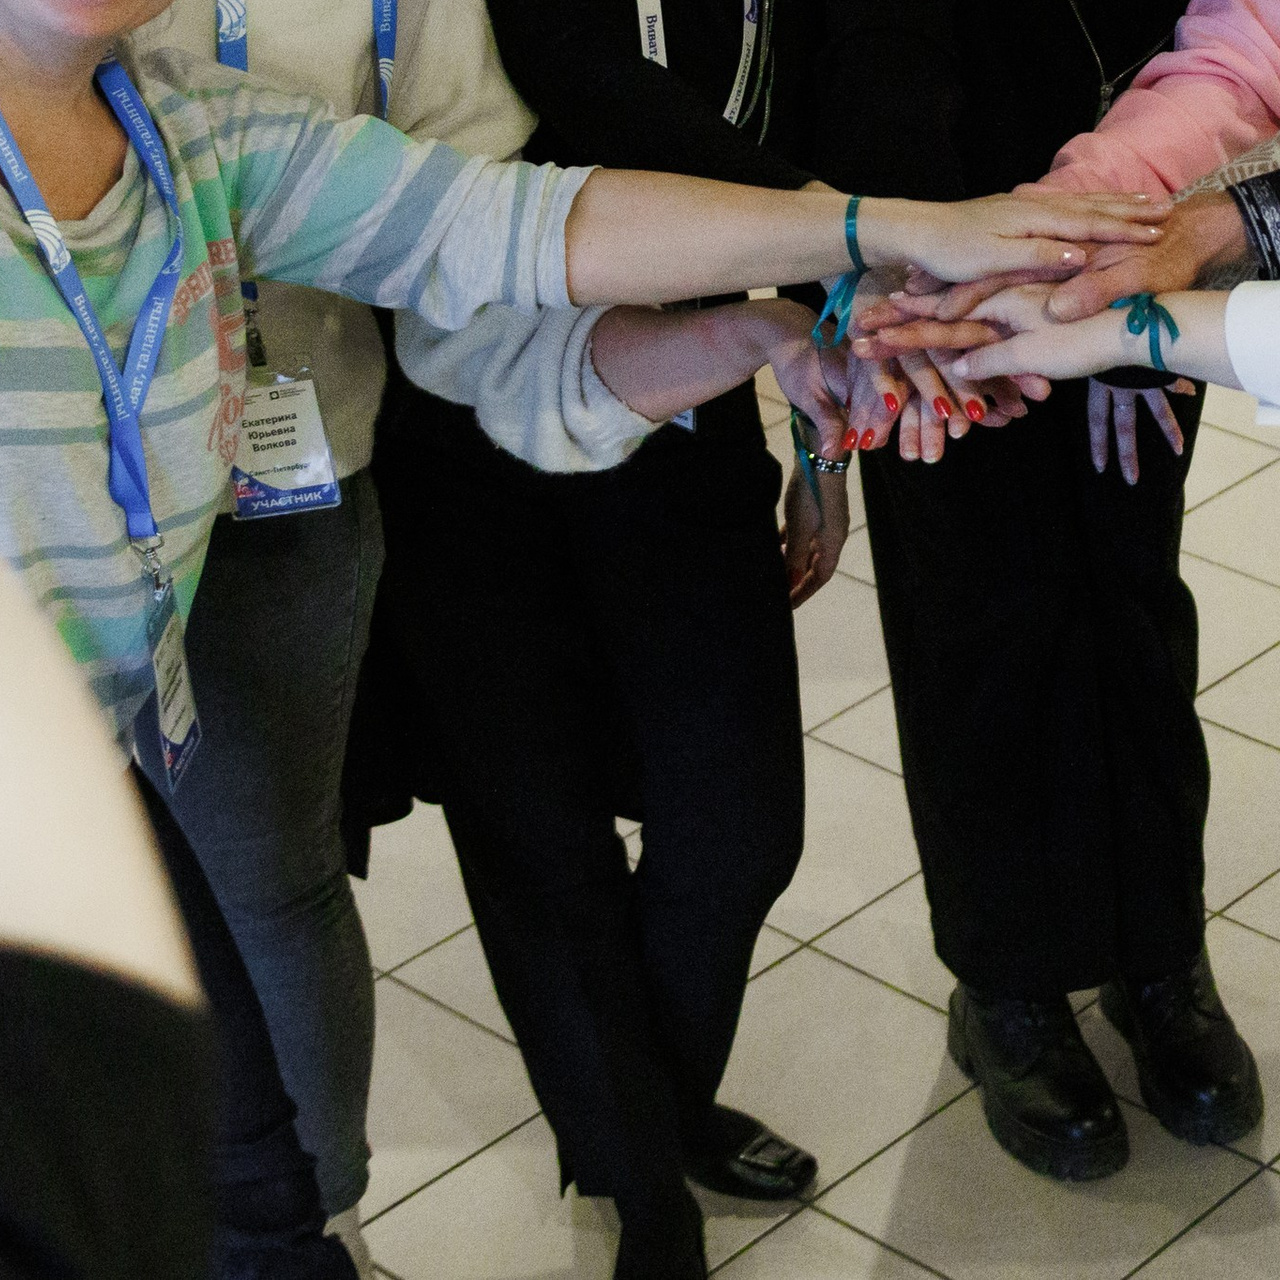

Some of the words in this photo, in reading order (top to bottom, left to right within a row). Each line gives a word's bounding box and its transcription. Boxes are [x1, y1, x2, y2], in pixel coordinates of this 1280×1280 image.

[111, 86, 154, 148] таланты!
[132, 295, 166, 374] таланты!
[73, 294, 99, 347] Виват,
[98, 346, 130, 421] таланты!
[129, 372, 147, 410] ват,
[241, 412, 298, 429] Екатерина
[248, 426, 296, 441] Юрьевна
[252, 438, 297, 453] Волкова
[251, 490, 323, 511] УЧАСТНИК
